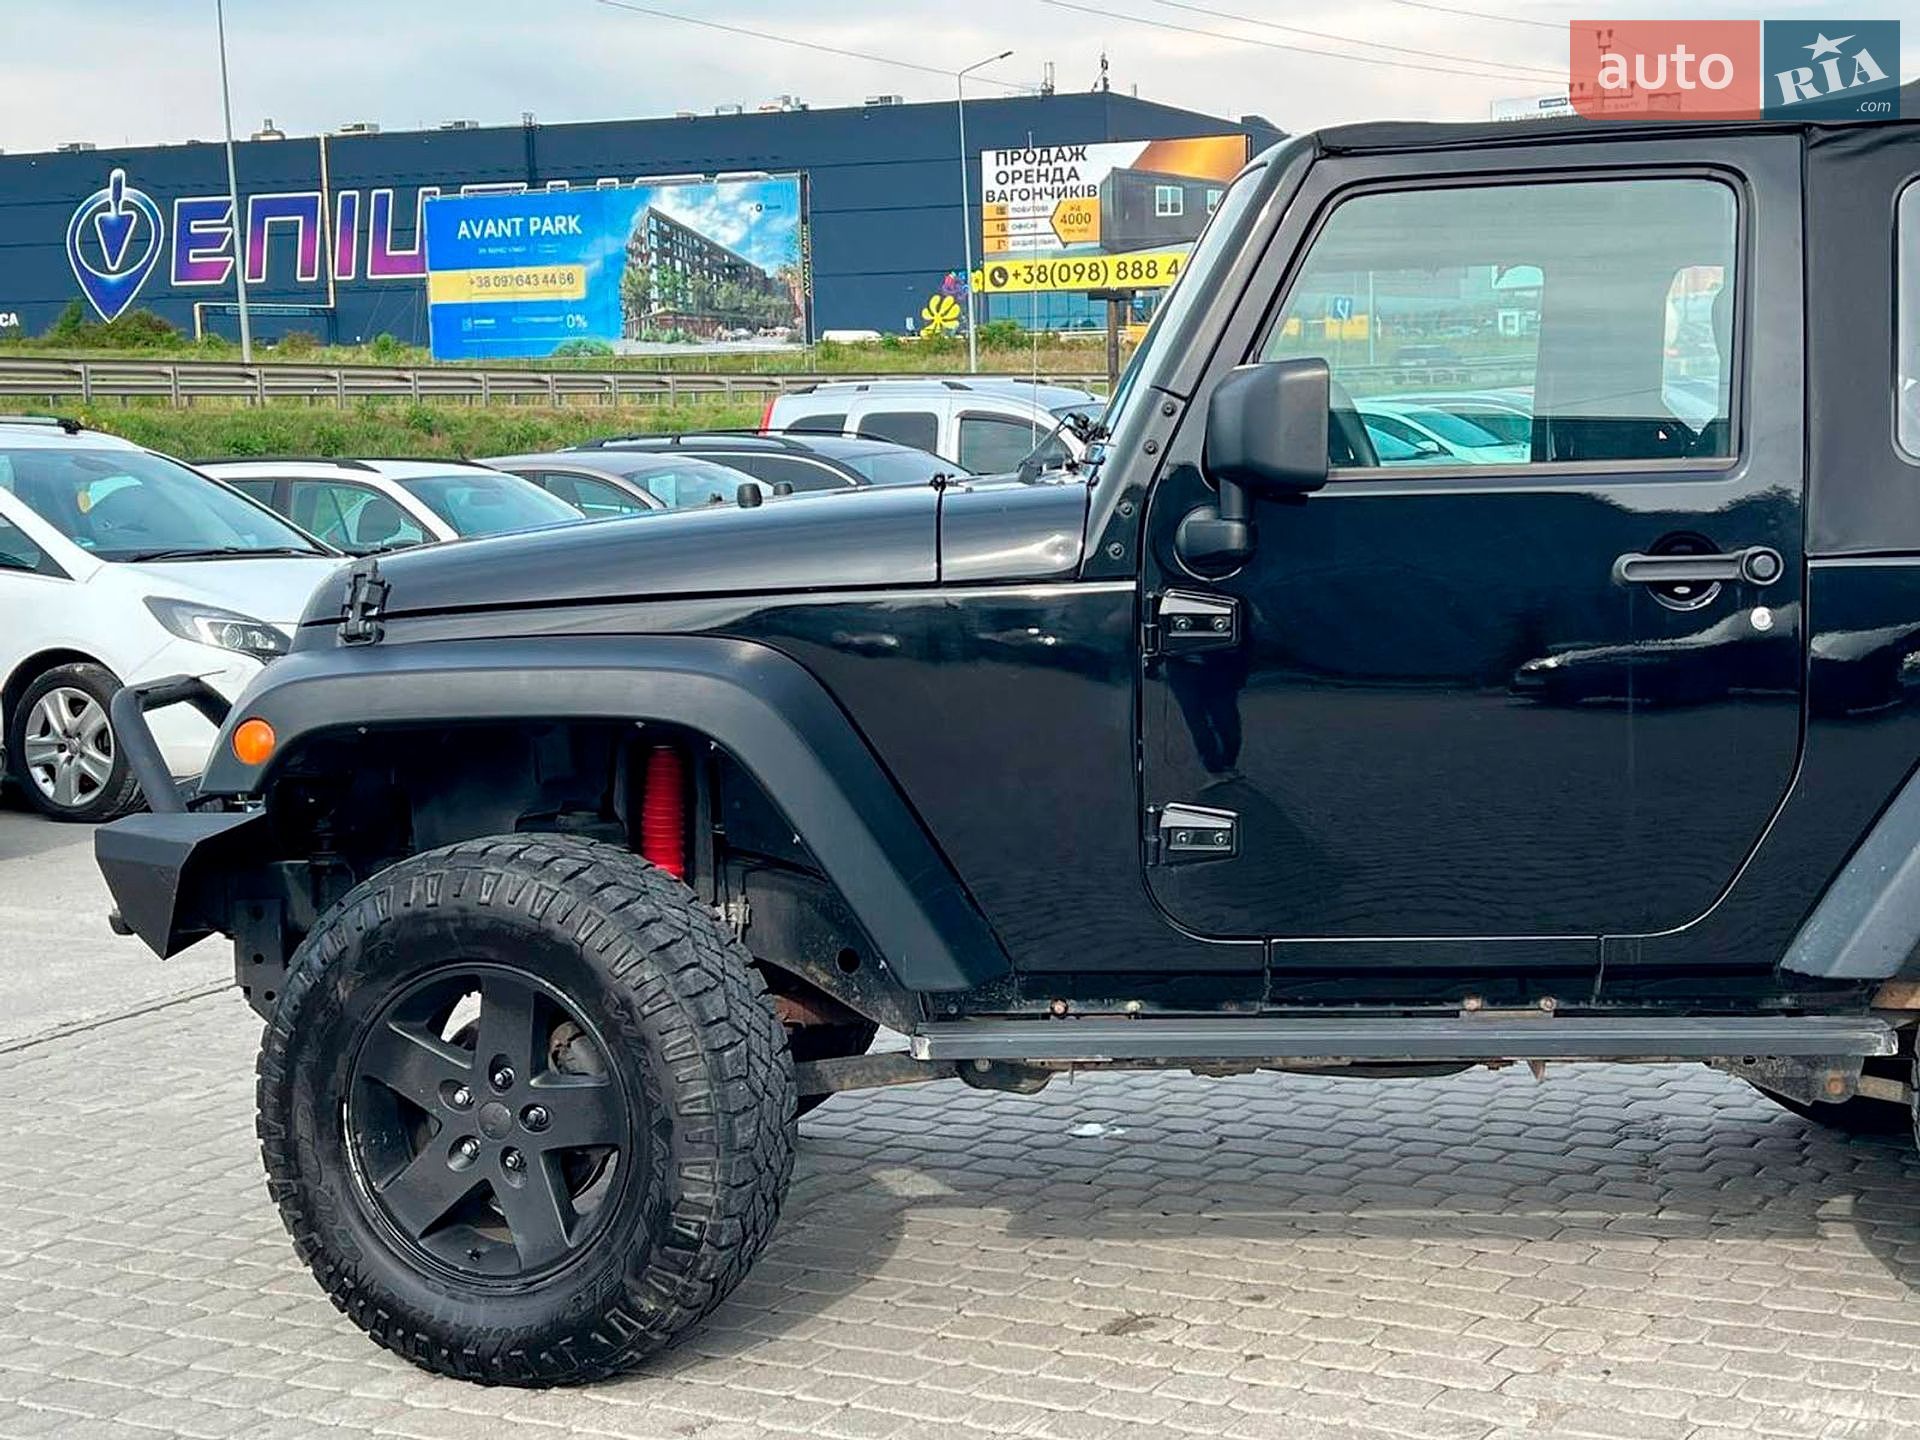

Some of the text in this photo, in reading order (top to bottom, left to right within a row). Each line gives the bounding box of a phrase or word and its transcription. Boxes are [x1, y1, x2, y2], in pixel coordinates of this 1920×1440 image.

[995, 146, 1087, 166] ПРОДАЖ
[995, 166, 1080, 185] ОРЕНДА
[985, 183, 1098, 203] ВАГОНЧИКІВ
[457, 214, 583, 240] AVANT PARK
[1060, 212, 1092, 226] 4000
[1012, 260, 1109, 287] +38(098)
[1115, 259, 1158, 279] 888
[566, 314, 588, 329] 0%
